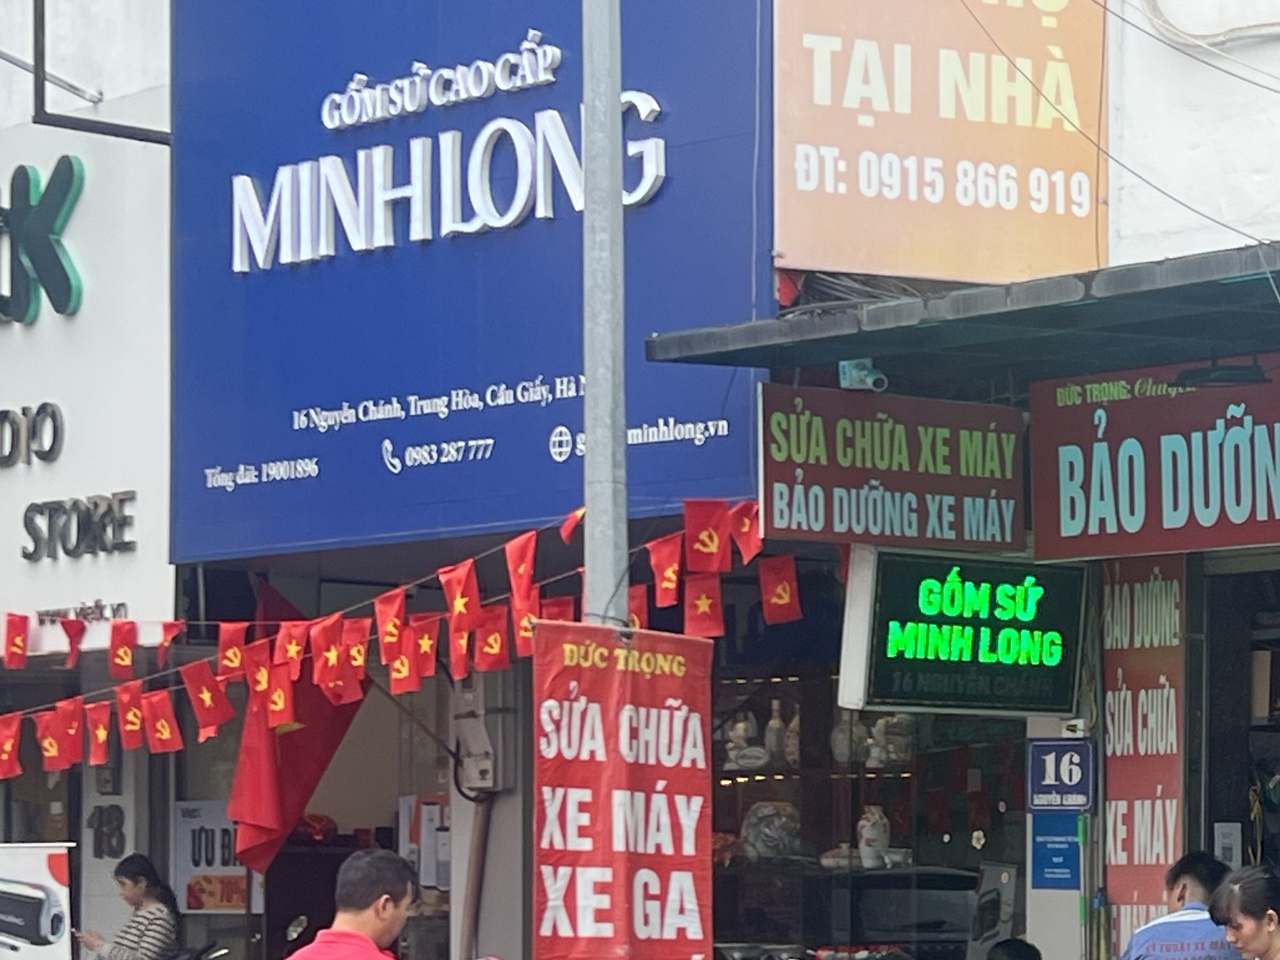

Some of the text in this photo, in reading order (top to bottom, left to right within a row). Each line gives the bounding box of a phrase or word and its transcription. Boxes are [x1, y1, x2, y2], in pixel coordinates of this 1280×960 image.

[321, 28, 562, 130] GỐM SỨ CAO CẤP
[802, 33, 1081, 131] TẠI NHÀ
[794, 144, 1091, 217] ĐT: 0915 866 919
[292, 410, 308, 430] 16
[309, 402, 357, 432] Nguyễn
[358, 397, 405, 421] Chánh,
[407, 395, 449, 419] Trung
[451, 389, 484, 410] Hòa,
[516, 375, 552, 407] Giấy,
[555, 375, 577, 398] Hà
[770, 397, 1016, 479] SỬA CHỮA XE MÁY
[204, 464, 235, 492] Tổng
[261, 457, 319, 482] 19001896
[404, 438, 495, 467] 0983 287 777
[1058, 408, 1146, 537] BẢO
[21, 490, 137, 562] STORE
[773, 468, 1015, 542] BẢO DƯỠNG XE MÁY
[918, 566, 1045, 622] GỐM SỨ
[562, 640, 687, 679] ĐỨC TRỌNG
[886, 620, 1063, 667] MINH LONG
[540, 681, 706, 769] SỬA CHỮA
[1105, 667, 1177, 757] SỬA CHỮA
[1041, 752, 1082, 785] 16
[87, 804, 126, 860] 18
[540, 780, 703, 856] XE MÁY
[1105, 784, 1177, 865] XE MÁY
[539, 865, 703, 940] XE GA
